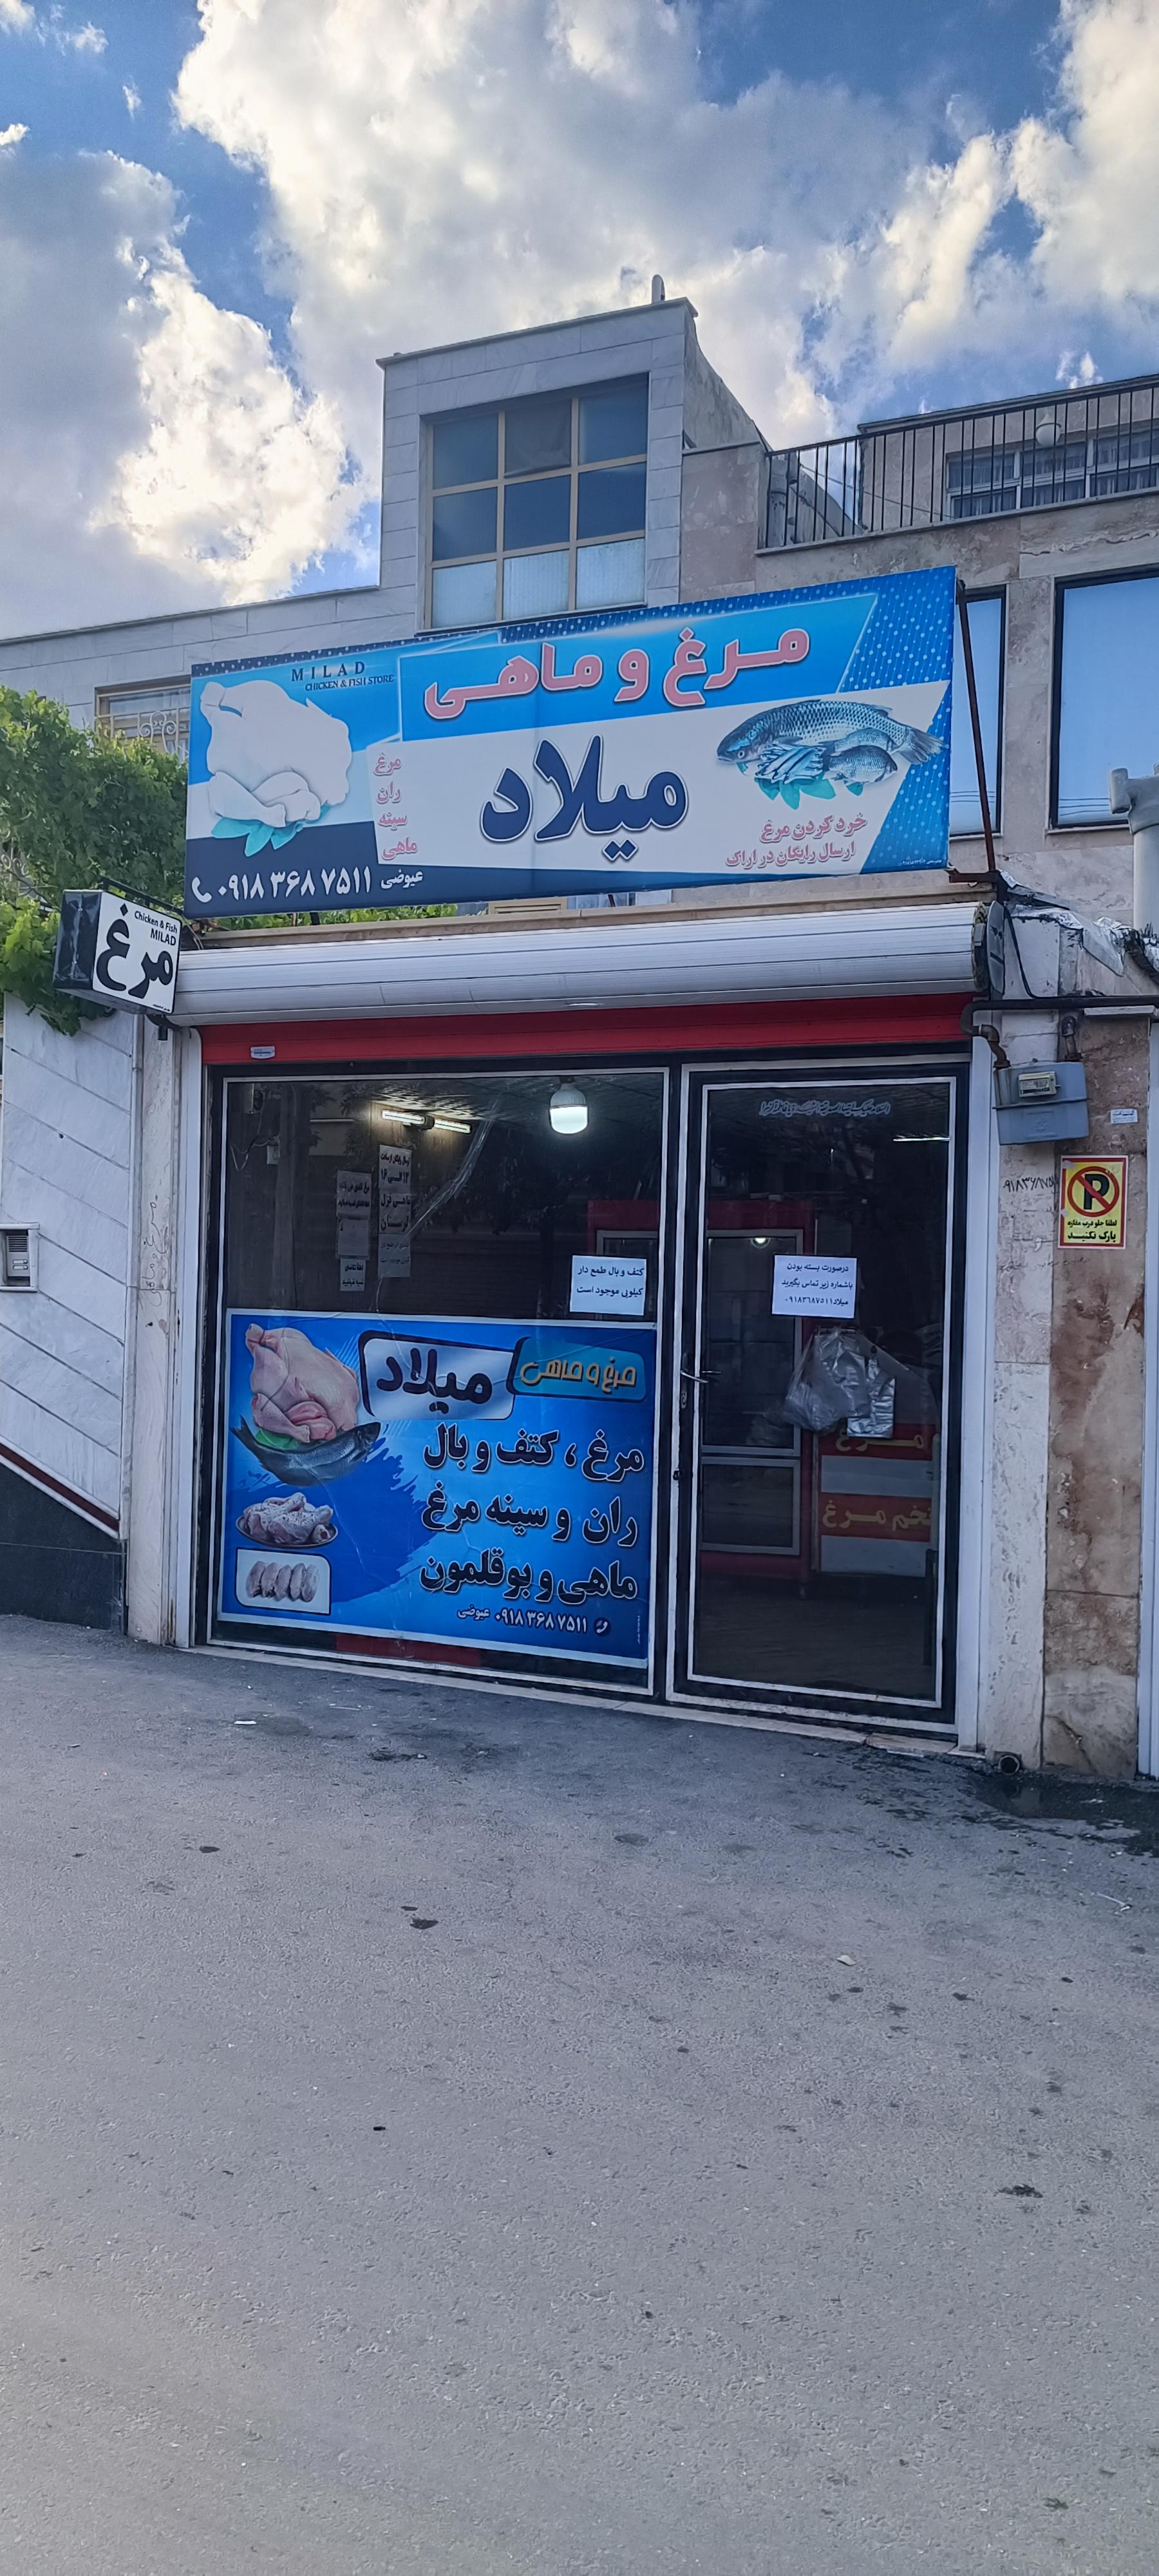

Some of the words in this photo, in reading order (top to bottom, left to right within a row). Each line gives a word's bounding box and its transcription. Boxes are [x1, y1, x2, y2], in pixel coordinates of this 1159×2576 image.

[291, 661, 365, 681] MILAD
[614, 649, 649, 703] و
[664, 628, 809, 707] مرغ
[305, 680, 339, 692] CHICKEN
[349, 678, 366, 687] FISH
[368, 674, 395, 685] STORE
[424, 642, 603, 721] ماهی
[373, 752, 402, 775] مرغ
[377, 781, 401, 803] ران
[480, 734, 689, 862] میلاد
[378, 811, 408, 830] سینه
[760, 819, 791, 843] مرغ
[792, 815, 834, 839] کردن
[835, 812, 868, 837] خرد
[382, 837, 418, 860] ماهی
[726, 849, 757, 870] اراک
[757, 850, 775, 868] در
[775, 844, 816, 867] رایگان
[818, 840, 856, 862] ارسال
[218, 873, 265, 900] ۰۹۱۸
[270, 869, 316, 898] ۳۶۸
[321, 866, 371, 895] ۷۵۱۱
[381, 869, 423, 889] عیوضی
[135, 911, 158, 925] Chicken
[159, 920, 165, 929] &
[165, 922, 178, 934] Fish
[150, 928, 176, 946] MILAD
[96, 903, 173, 999] مرغ
[1083, 1173, 1110, 1210] P
[1094, 1219, 1104, 1228] جلو
[1068, 1231, 1096, 1242] نکنید
[1098, 1230, 1116, 1243] پارک
[578, 1265, 589, 1275] دار
[590, 1265, 607, 1277] طمع
[608, 1267, 619, 1277] بال
[627, 1267, 645, 1276] کتف
[787, 1263, 802, 1272] بودن
[804, 1264, 820, 1273] بسته
[576, 1285, 594, 1294] است
[595, 1287, 619, 1297] موجود
[781, 1277, 800, 1288] بگیرید
[802, 1280, 819, 1288] تماس
[819, 1280, 829, 1290] زیر
[376, 1347, 493, 1414] میلاد
[520, 1359, 583, 1386] ماهی
[586, 1362, 600, 1387] و
[600, 1356, 637, 1395] مرغ
[423, 1422, 468, 1470] بال
[471, 1439, 491, 1473] و
[495, 1428, 560, 1465] کتف
[581, 1429, 645, 1482] مرغ
[422, 1481, 480, 1532] مرغ
[485, 1493, 548, 1535] سینه
[822, 1499, 886, 1528] مرغ
[552, 1508, 570, 1541] و
[582, 1495, 637, 1547] ران
[535, 1569, 554, 1602] و
[557, 1560, 638, 1605] ماهی
[458, 1605, 489, 1620] عیوضی
